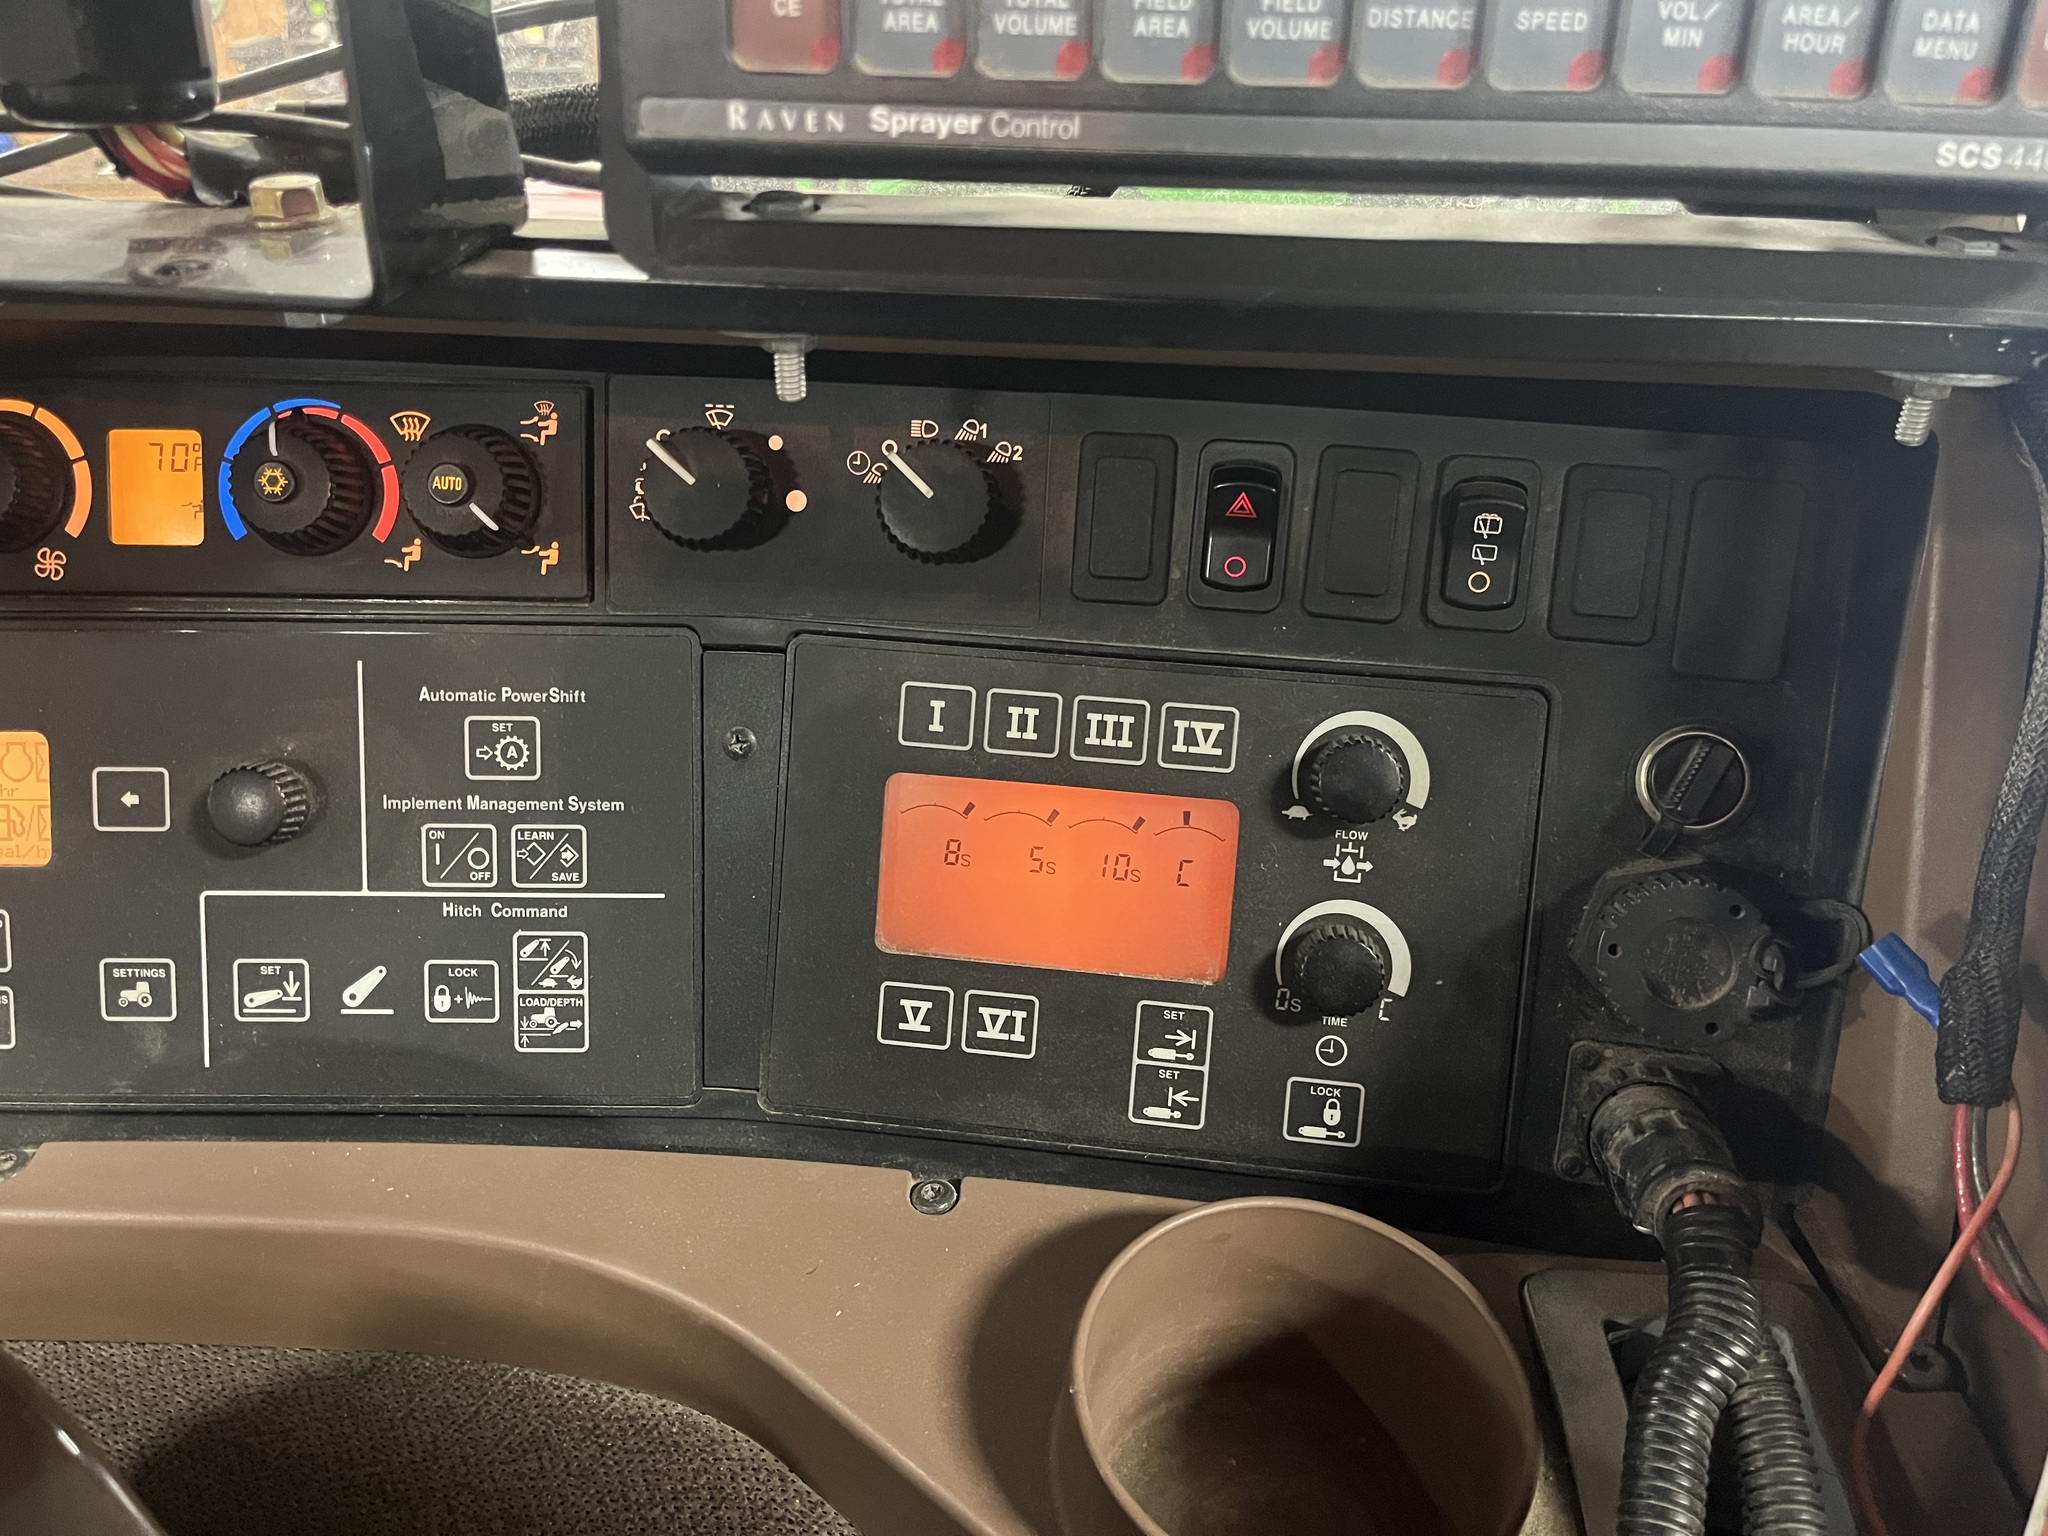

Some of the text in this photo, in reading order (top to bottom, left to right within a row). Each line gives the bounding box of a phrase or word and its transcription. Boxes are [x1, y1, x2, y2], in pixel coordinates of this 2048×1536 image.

[1367, 8, 1474, 30] DISTANCE
[1658, 0, 1719, 22] VOL/
[1781, 4, 1861, 27] AREA/
[882, 12, 940, 33] AREA
[993, 14, 1078, 36] VOLUME
[1133, 17, 1191, 39] AREA
[1246, 19, 1333, 41] VOLUME
[1515, 11, 1589, 32] SPEED
[1921, 9, 1980, 34] DATA
[1662, 27, 1703, 48] MIN
[1782, 31, 1847, 54] HOUR
[1913, 36, 1979, 61] MENU
[726, 101, 1082, 139] RAVEN Sprayer Control
[1935, 140, 2003, 171] SCS
[979, 422, 988, 439] 1
[1012, 445, 1024, 461] 2
[432, 475, 463, 492] AUTO
[419, 686, 497, 702] Automatic
[491, 723, 513, 732] SET
[1006, 706, 1040, 740] II
[1084, 712, 1135, 748] III
[1171, 719, 1225, 756] IV
[382, 794, 625, 813] Implement Management System
[428, 830, 445, 840] ON
[517, 831, 555, 841] LEARN
[1335, 829, 1369, 841] FLOW
[469, 871, 491, 881] OFF
[551, 872, 580, 882] SAVE
[442, 902, 568, 919] Hitch Command
[112, 968, 166, 979] SETTINGS
[260, 966, 281, 976] SET
[448, 967, 478, 978] LOCK
[519, 997, 583, 1009] LOAD/DEPTH
[898, 998, 933, 1032] V
[976, 1006, 1028, 1042] VI
[1163, 1009, 1185, 1021] SET
[1321, 1015, 1348, 1027] TIME
[1158, 1069, 1180, 1080] SET
[1310, 1085, 1342, 1098] LOCK
